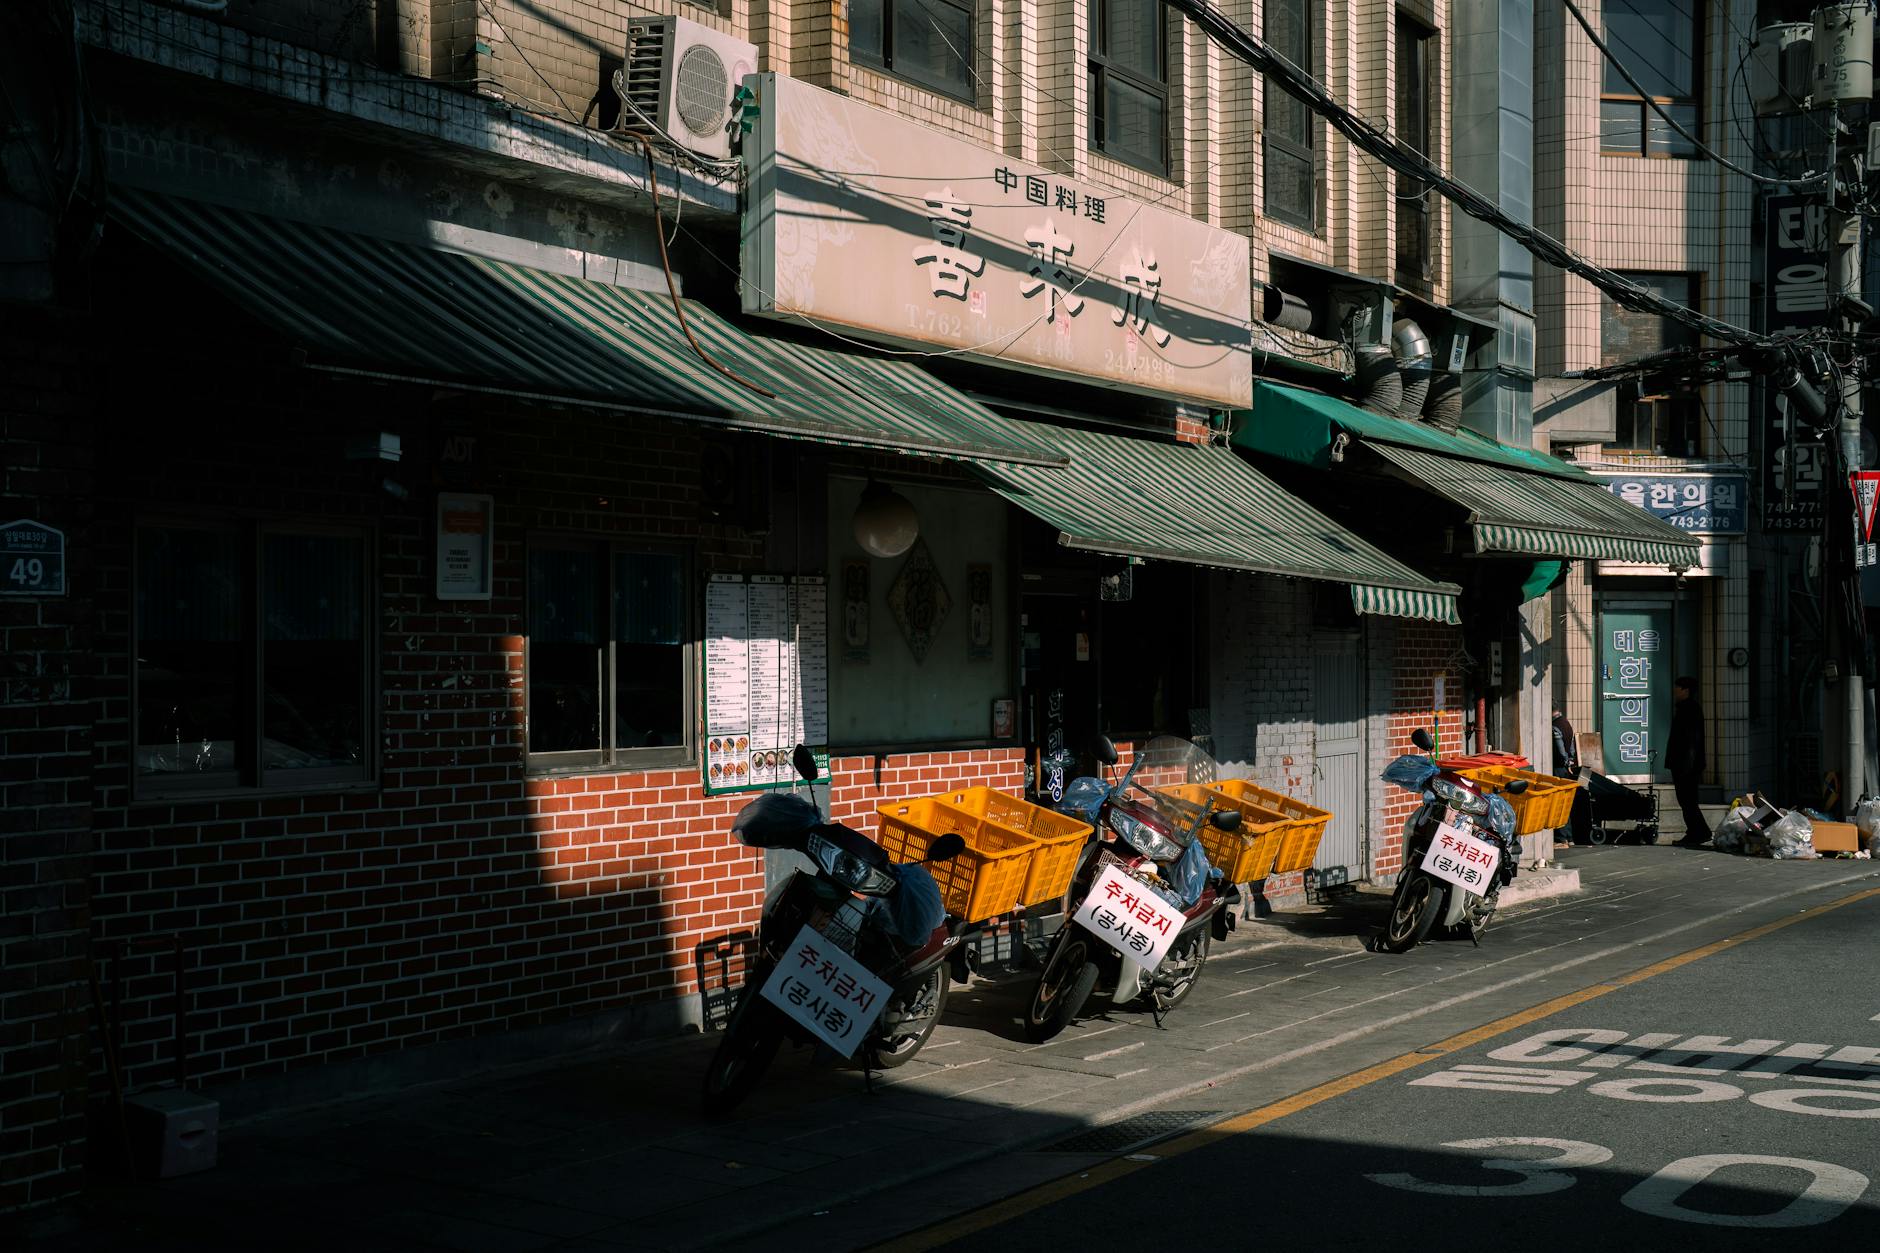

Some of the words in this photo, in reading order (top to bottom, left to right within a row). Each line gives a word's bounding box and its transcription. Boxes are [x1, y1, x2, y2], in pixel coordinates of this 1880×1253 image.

[994, 166, 1106, 225] 中国料理
[1772, 206, 1829, 492] 태을원
[1670, 516, 1730, 529] 743-2176
[10, 558, 43, 585] 49
[1613, 629, 1660, 652] 태을
[1619, 656, 1652, 764] 한의원
[1433, 855, 1482, 886] (공사중)
[1440, 834, 1493, 868] 주차금지
[1091, 905, 1155, 957] (공사중)
[1104, 880, 1172, 936] 주차금지
[798, 944, 875, 1013] 주차금지
[780, 976, 853, 1039] (공사중)
[1362, 1136, 1870, 1229] 30
